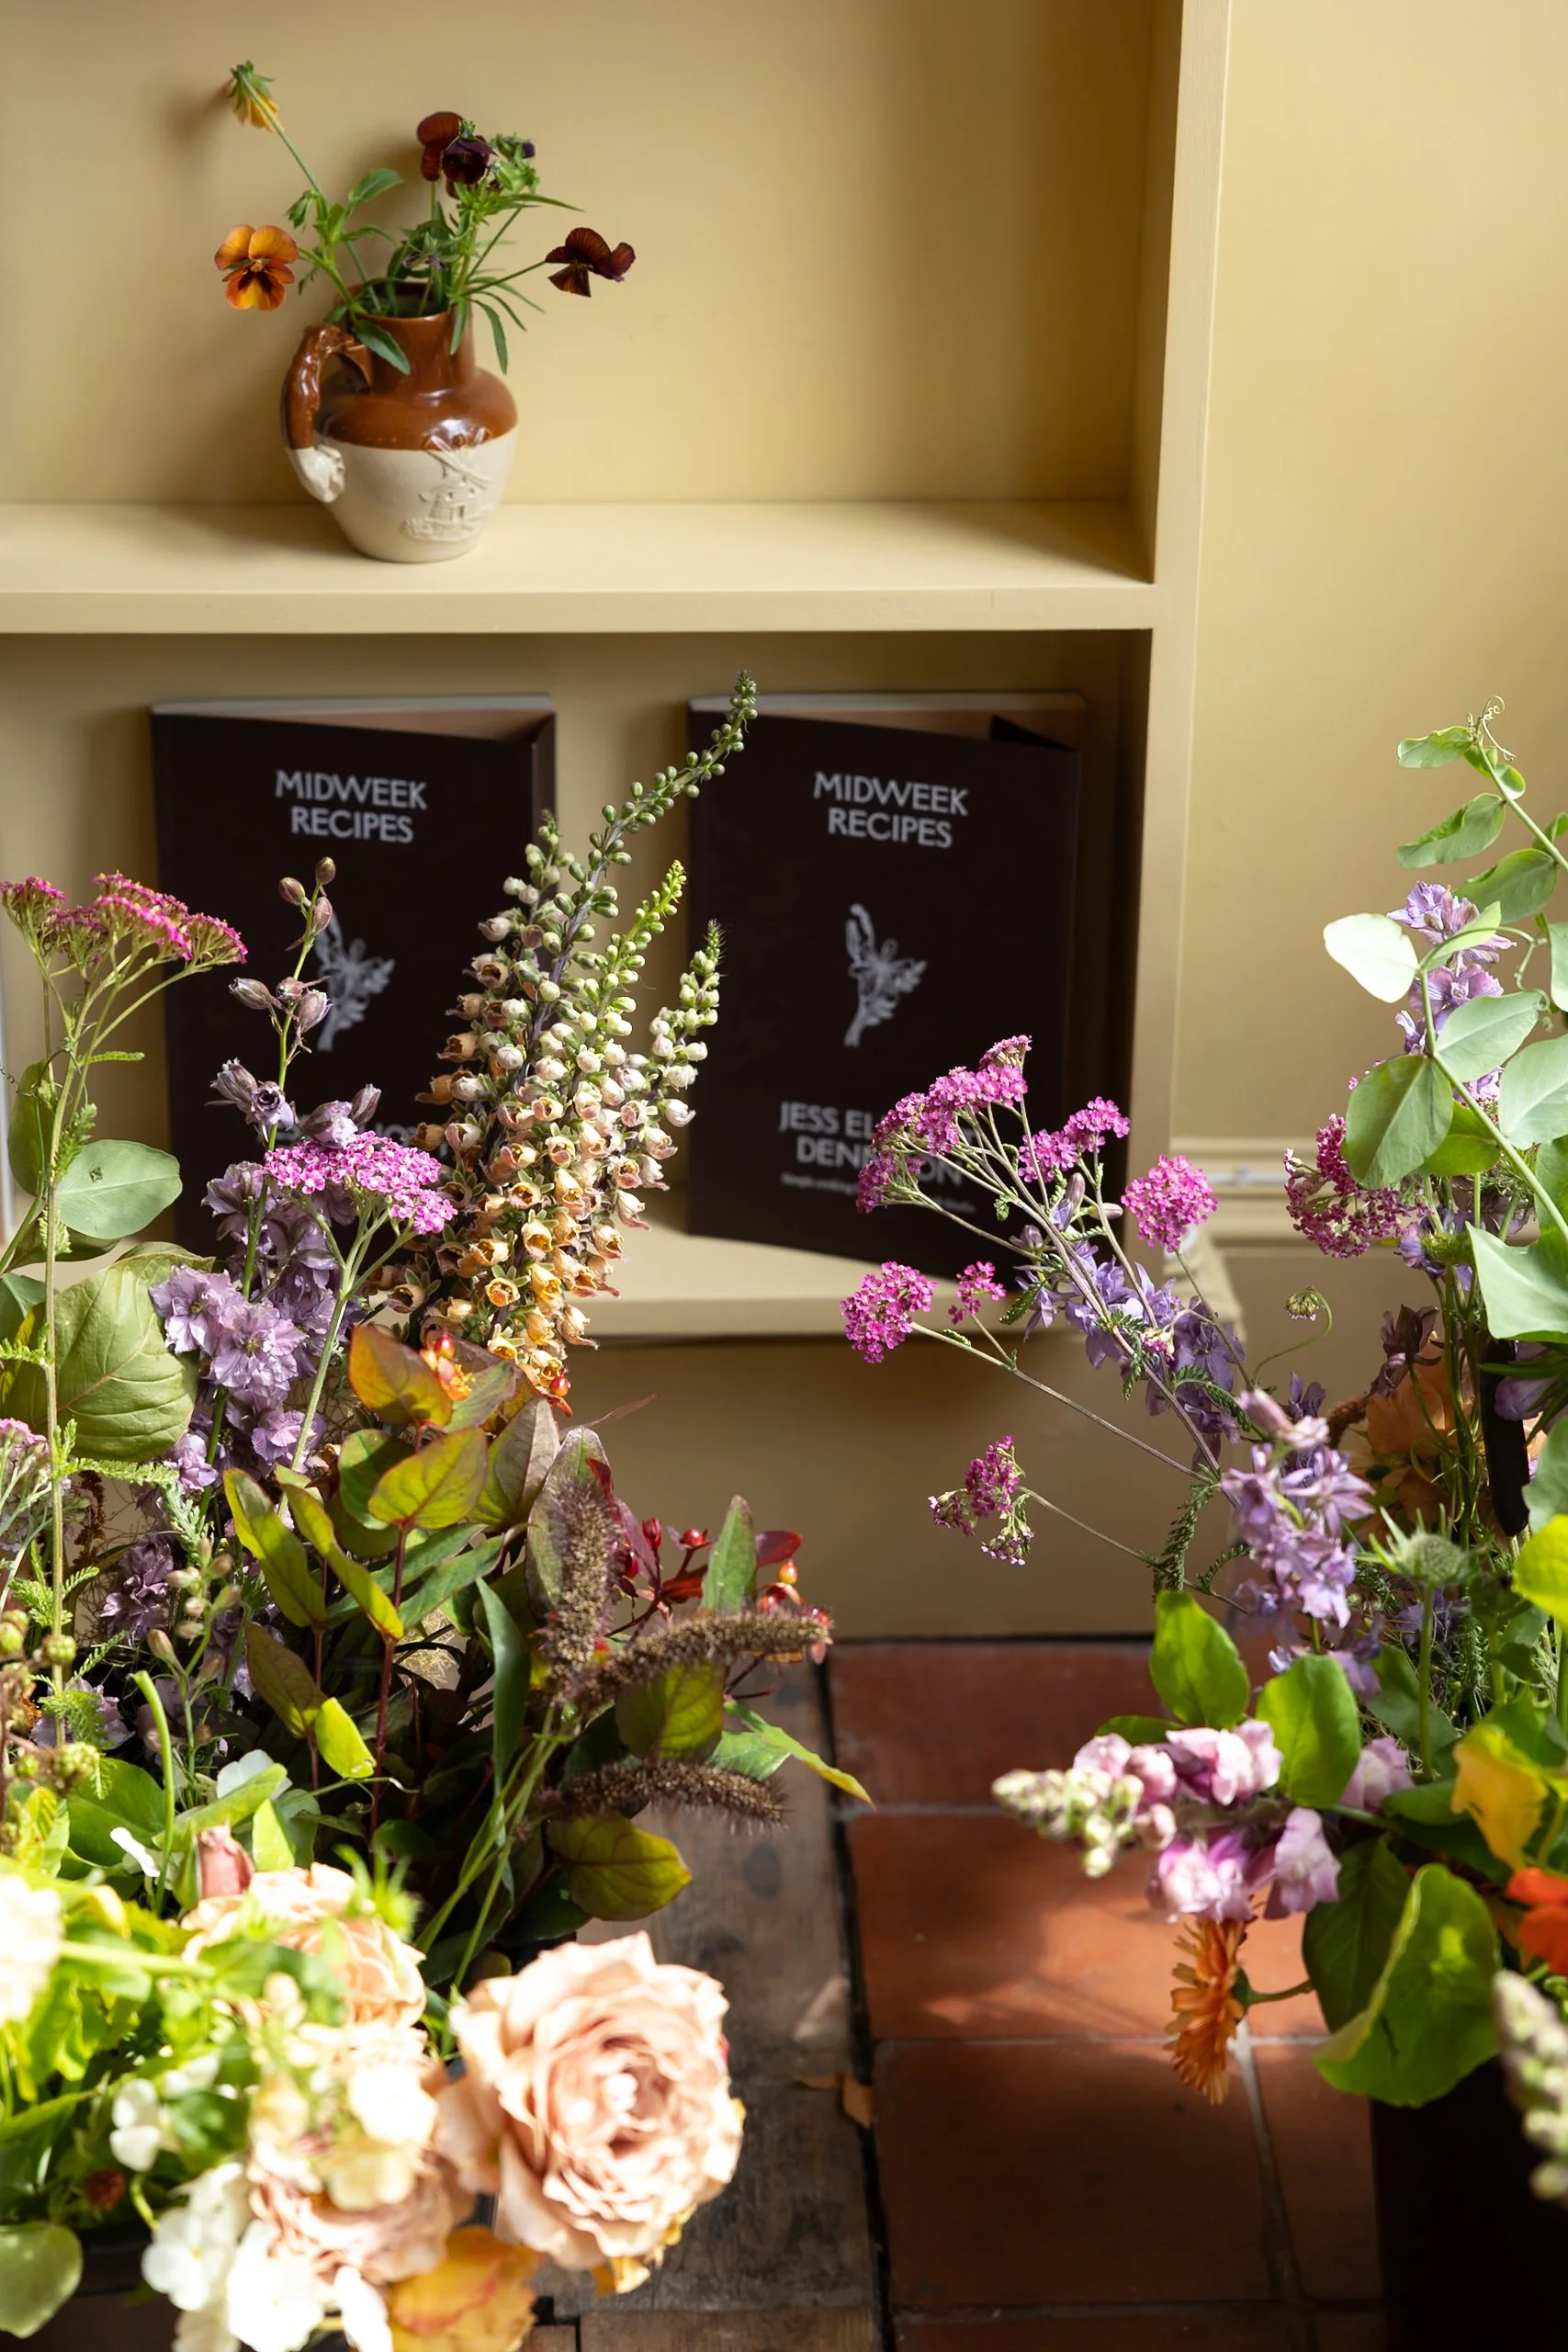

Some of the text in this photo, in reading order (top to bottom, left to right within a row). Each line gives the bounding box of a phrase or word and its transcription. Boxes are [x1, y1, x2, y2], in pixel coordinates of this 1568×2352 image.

[275, 769, 428, 810] MIDWEEK
[812, 770, 969, 817] MIDWEEK
[290, 805, 414, 844] RECIPES
[828, 807, 953, 849] RECIPES
[779, 1102, 840, 1135] JESS
[795, 1135, 964, 1186] DENON
